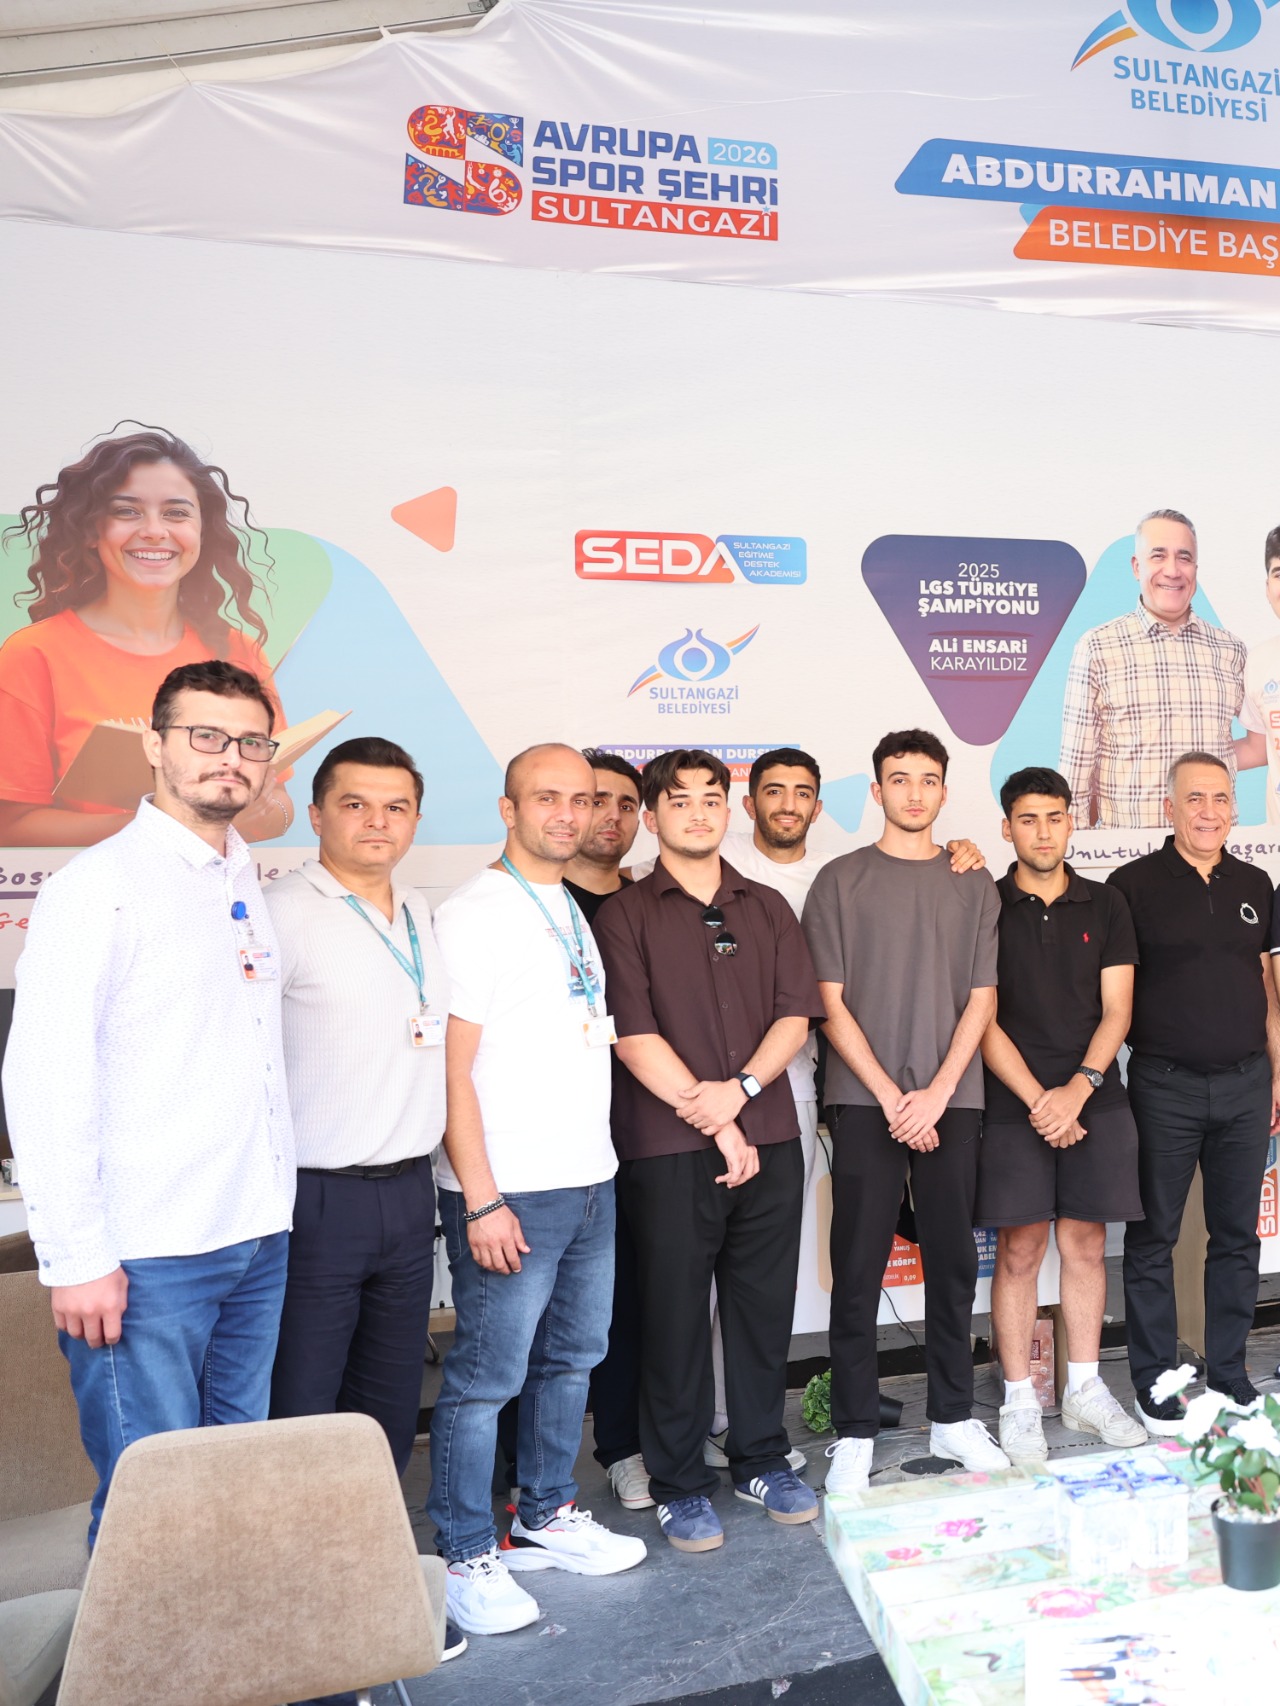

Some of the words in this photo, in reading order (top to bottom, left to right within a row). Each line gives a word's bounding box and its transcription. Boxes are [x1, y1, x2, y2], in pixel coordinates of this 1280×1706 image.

[1113, 55, 1280, 97] SULTANGAZİ
[1130, 88, 1268, 122] BELEDİYESİ
[533, 120, 701, 163] AVRUPA
[713, 143, 771, 164] 2026
[532, 157, 644, 195] SPOR
[659, 168, 778, 206] ŞEHRİ
[941, 153, 1277, 209] ABDURRAHMAN
[538, 197, 772, 237] SULTANGAZİ
[1049, 218, 1208, 256] BELEDİYE
[582, 537, 746, 583] SEDA
[744, 560, 780, 568] DESTEK
[958, 563, 1000, 579] 2025
[919, 580, 954, 595] LGS
[957, 577, 1038, 597] TÜRKİYE
[918, 598, 1039, 617] ŞAMPİYONU
[931, 656, 1027, 671] KARAYILDIZ
[649, 685, 739, 700] SULTANGAZİ
[657, 700, 731, 714] BELEDİYESİ
[893, 1258, 916, 1266] KÖRPE
